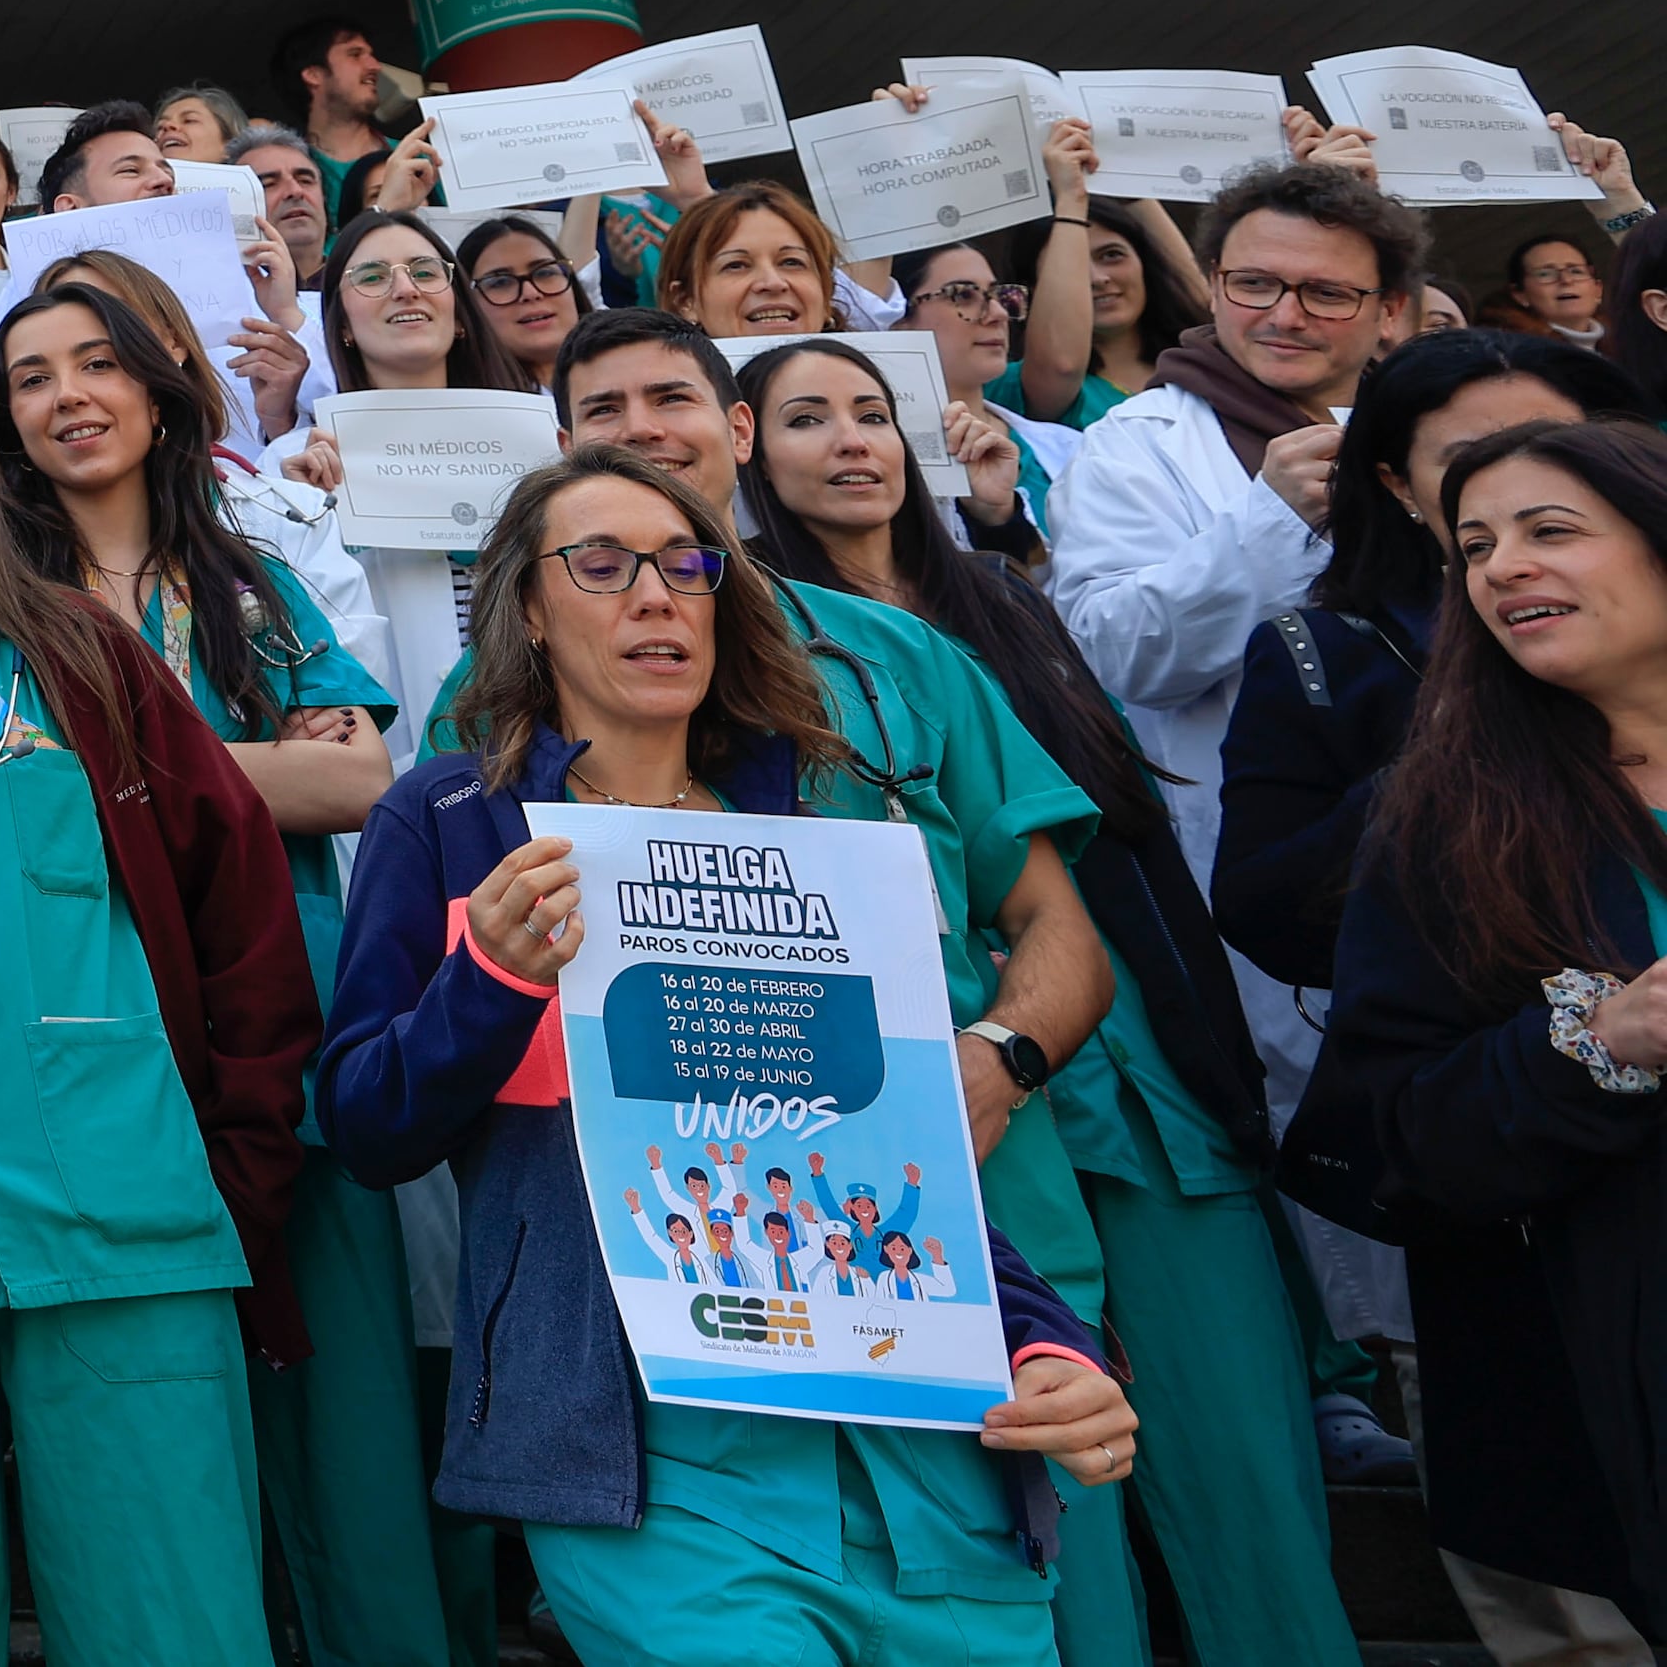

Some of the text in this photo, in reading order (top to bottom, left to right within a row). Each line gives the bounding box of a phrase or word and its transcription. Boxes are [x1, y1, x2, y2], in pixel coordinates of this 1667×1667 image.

[646, 72, 714, 93] MÉDICOS
[667, 87, 734, 108] SANIDAD
[1381, 91, 1484, 104] LA VOCACIÓN NO
[1130, 106, 1190, 116] VOCACIÓN
[1192, 109, 1208, 118] NO
[460, 130, 485, 142] SOY
[487, 122, 533, 138] MÉDICO
[1147, 128, 1250, 143] NUESTRA BATERÍA
[1420, 118, 1529, 132] NUESTRA BATERÍA
[499, 139, 517, 149] NO
[856, 159, 903, 178] HORA
[862, 155, 1002, 197] HORA COMPUTADA
[554, 184, 567, 196] del
[569, 179, 603, 193] Médico
[386, 439, 503, 456] SIN MÉDICOS
[376, 462, 526, 476] NO HAY SANIDAD
[420, 530, 480, 540] Estatuto del
[433, 780, 482, 810] TRIBORD
[649, 841, 793, 890] HUELGA
[620, 883, 837, 937] INDEFINIDA
[620, 933, 850, 965] PAROS CONVOCADOS
[660, 973, 825, 998] 16 al 20 de FEBRERO
[663, 995, 815, 1019] 16 al 20 de MARZO
[667, 1016, 806, 1039] 27 al 30 de ABRIL
[670, 1039, 814, 1063] 18 al 22 de MAYO
[674, 1062, 813, 1086] 15 al 19 de JUNIO
[674, 1086, 842, 1141] UNIDOS
[690, 1293, 815, 1348] CESM
[853, 1325, 905, 1338] FASAMET
[700, 1340, 818, 1359] Sindicato de Médicos de ARAGÓN
